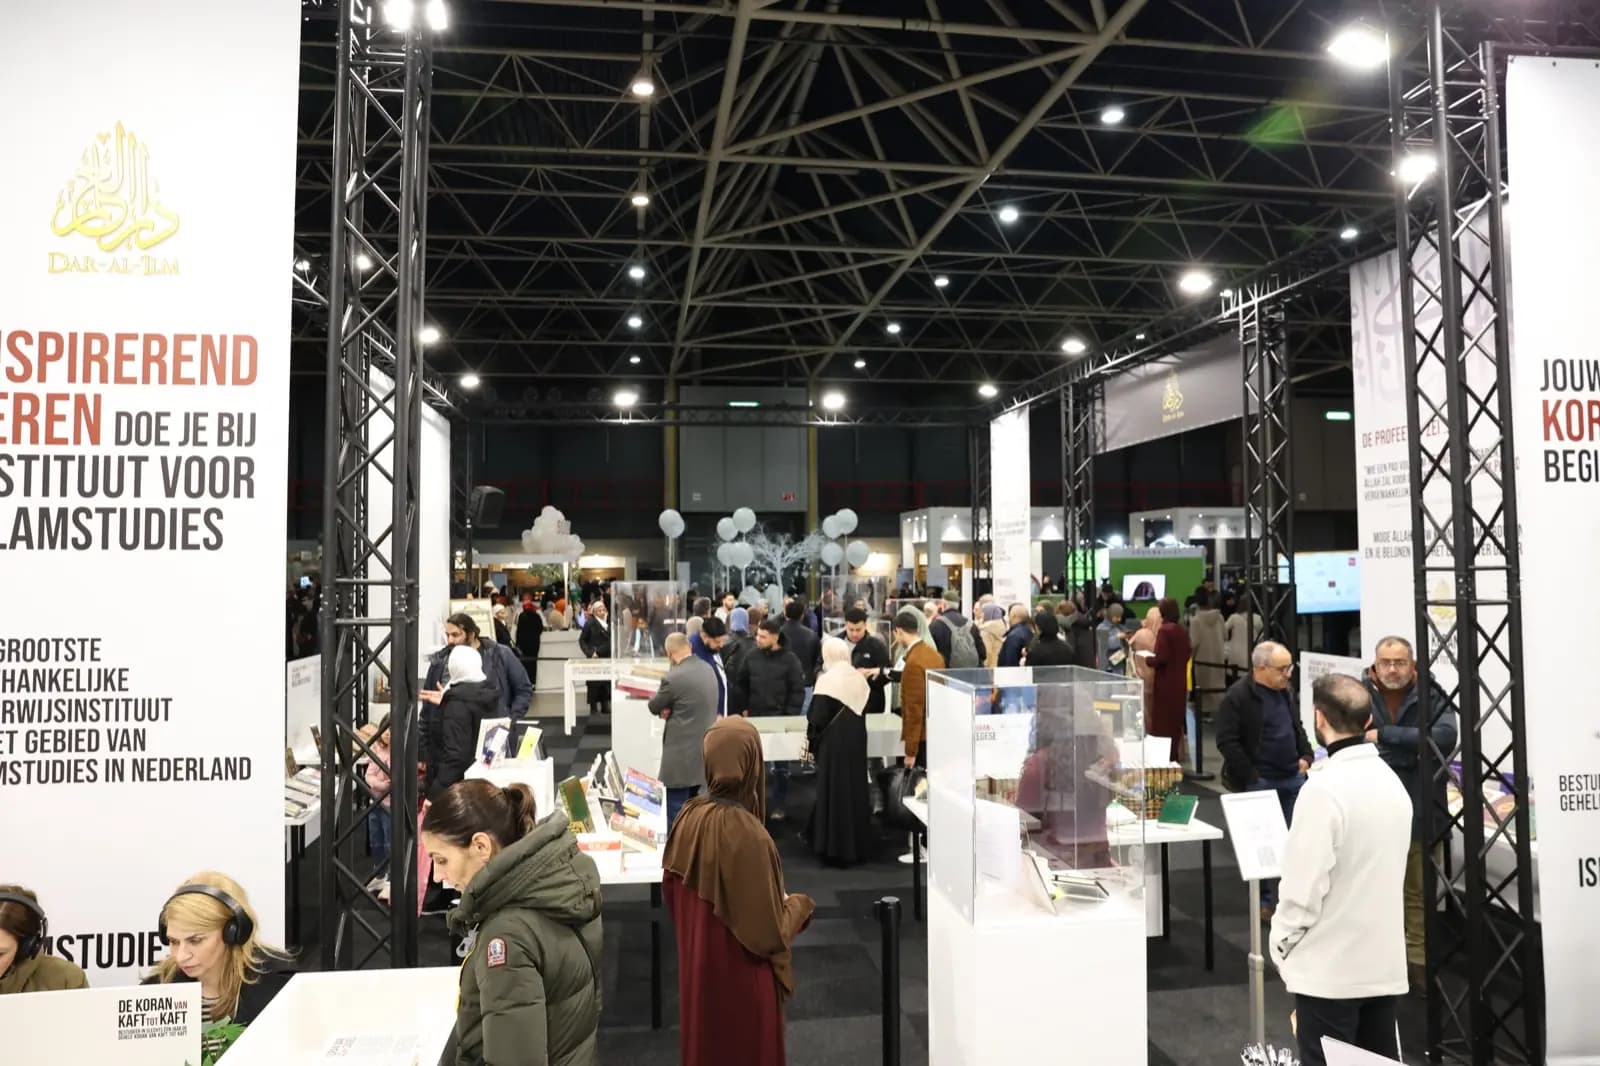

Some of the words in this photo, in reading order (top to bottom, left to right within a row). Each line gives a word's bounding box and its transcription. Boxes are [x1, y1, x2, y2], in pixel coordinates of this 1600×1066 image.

[0, 330, 258, 386] SPIREREND
[114, 411, 171, 447] DOE
[178, 412, 208, 447] JE
[217, 412, 256, 447] BIJ
[1362, 431, 1372, 448] DE
[1375, 425, 1408, 446] PROFEE
[160, 455, 255, 499] VOOR
[0, 667, 129, 694] HANKELIJKE
[1, 697, 173, 724] RWIJSINSTITUUT
[25, 728, 100, 754] GEBIED
[107, 728, 146, 752] VAN
[105, 758, 124, 783] IN
[131, 756, 252, 783] NEDERLAND
[1559, 773, 1600, 792] BESTU
[1560, 793, 1600, 811] GEHEL
[1579, 857, 1600, 888] IS
[41, 931, 163, 969] STUDIE
[119, 999, 133, 1013] DE
[136, 997, 172, 1012] KORAN
[174, 1000, 187, 1010] VAN
[118, 1013, 146, 1028] KAFT
[160, 1011, 187, 1025] KAFT
